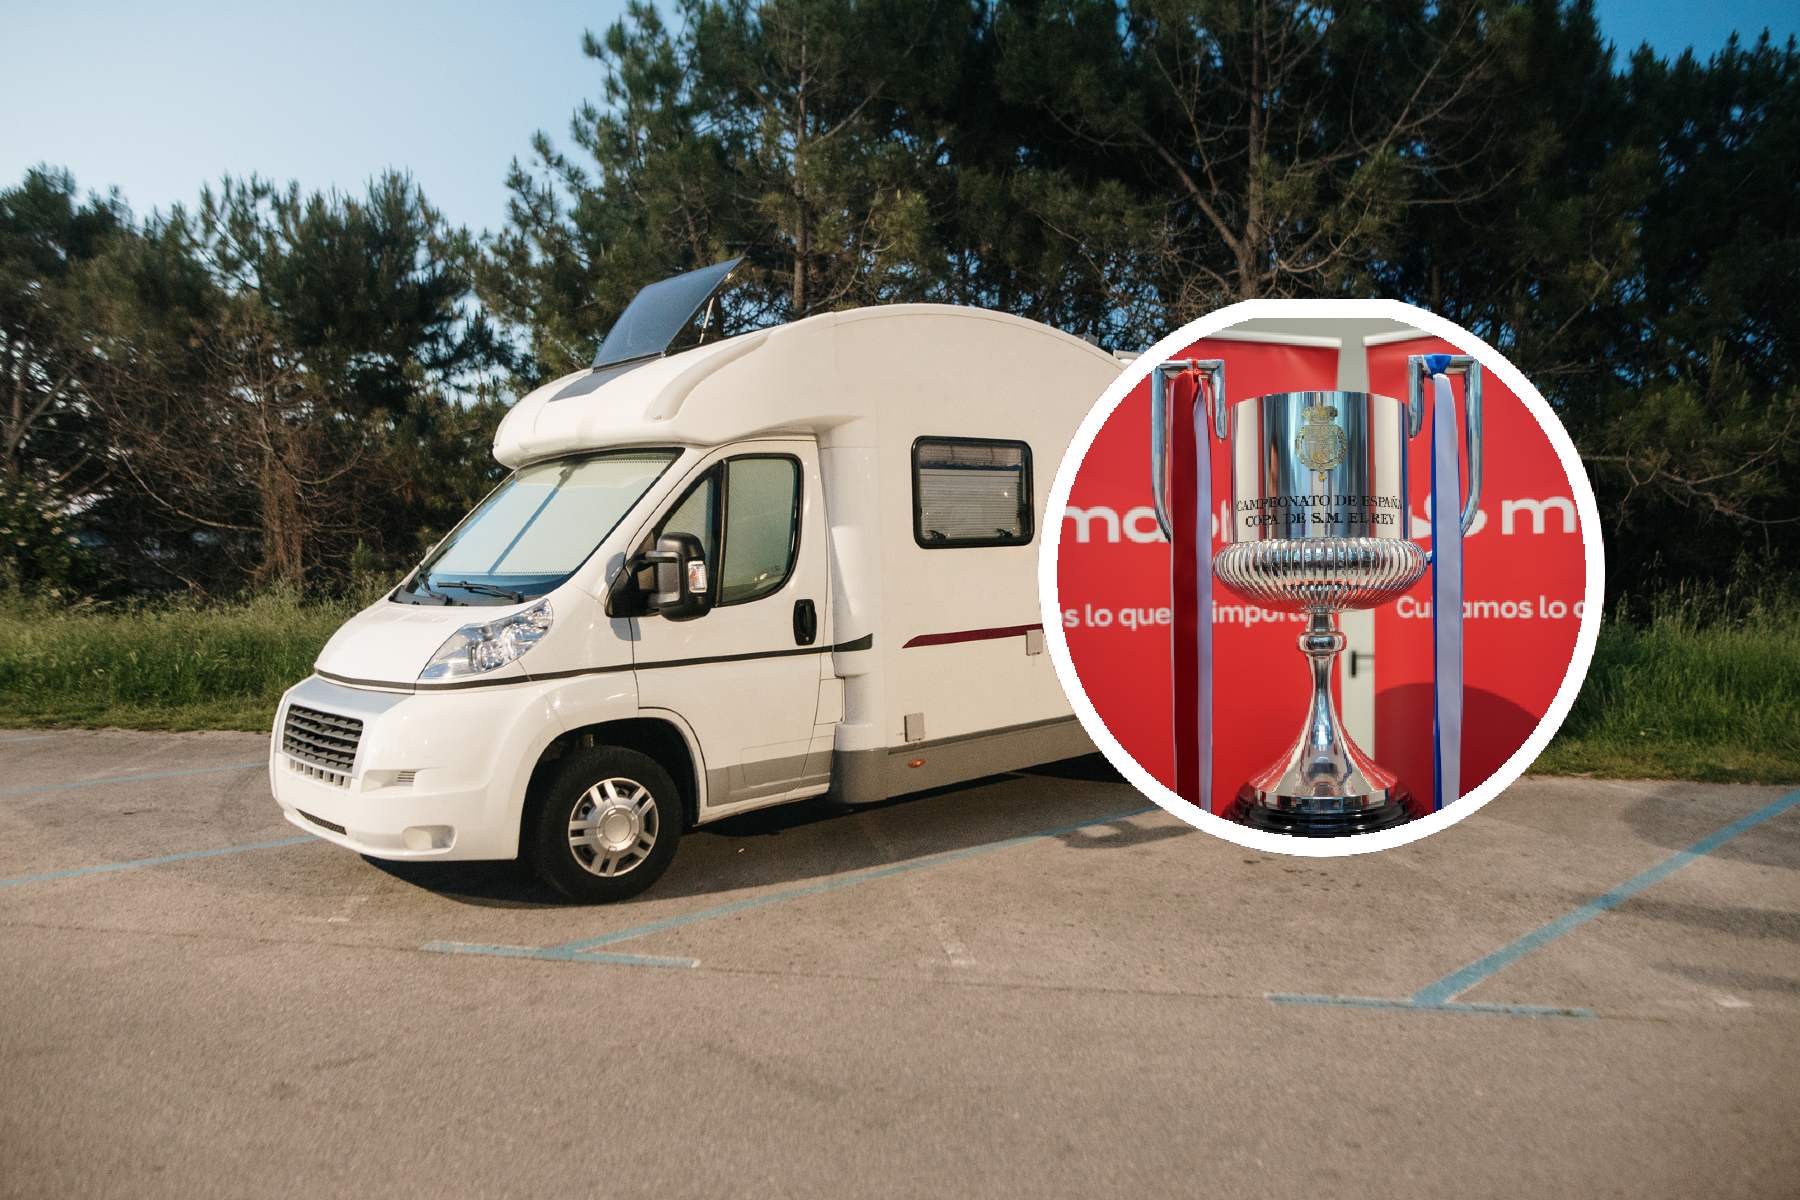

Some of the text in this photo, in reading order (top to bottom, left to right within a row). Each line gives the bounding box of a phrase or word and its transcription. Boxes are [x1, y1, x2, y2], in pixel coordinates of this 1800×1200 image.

[1236, 495, 1331, 511] CAMPEONATO
[1334, 495, 1357, 507] DE
[1245, 514, 1280, 527] COPA
[1286, 513, 1306, 524] DE
[1349, 512, 1369, 524] EL
[1371, 513, 1395, 525] REY
[1539, 594, 1567, 619] lo
[1085, 603, 1113, 628] lo
[1118, 607, 1171, 631] que
